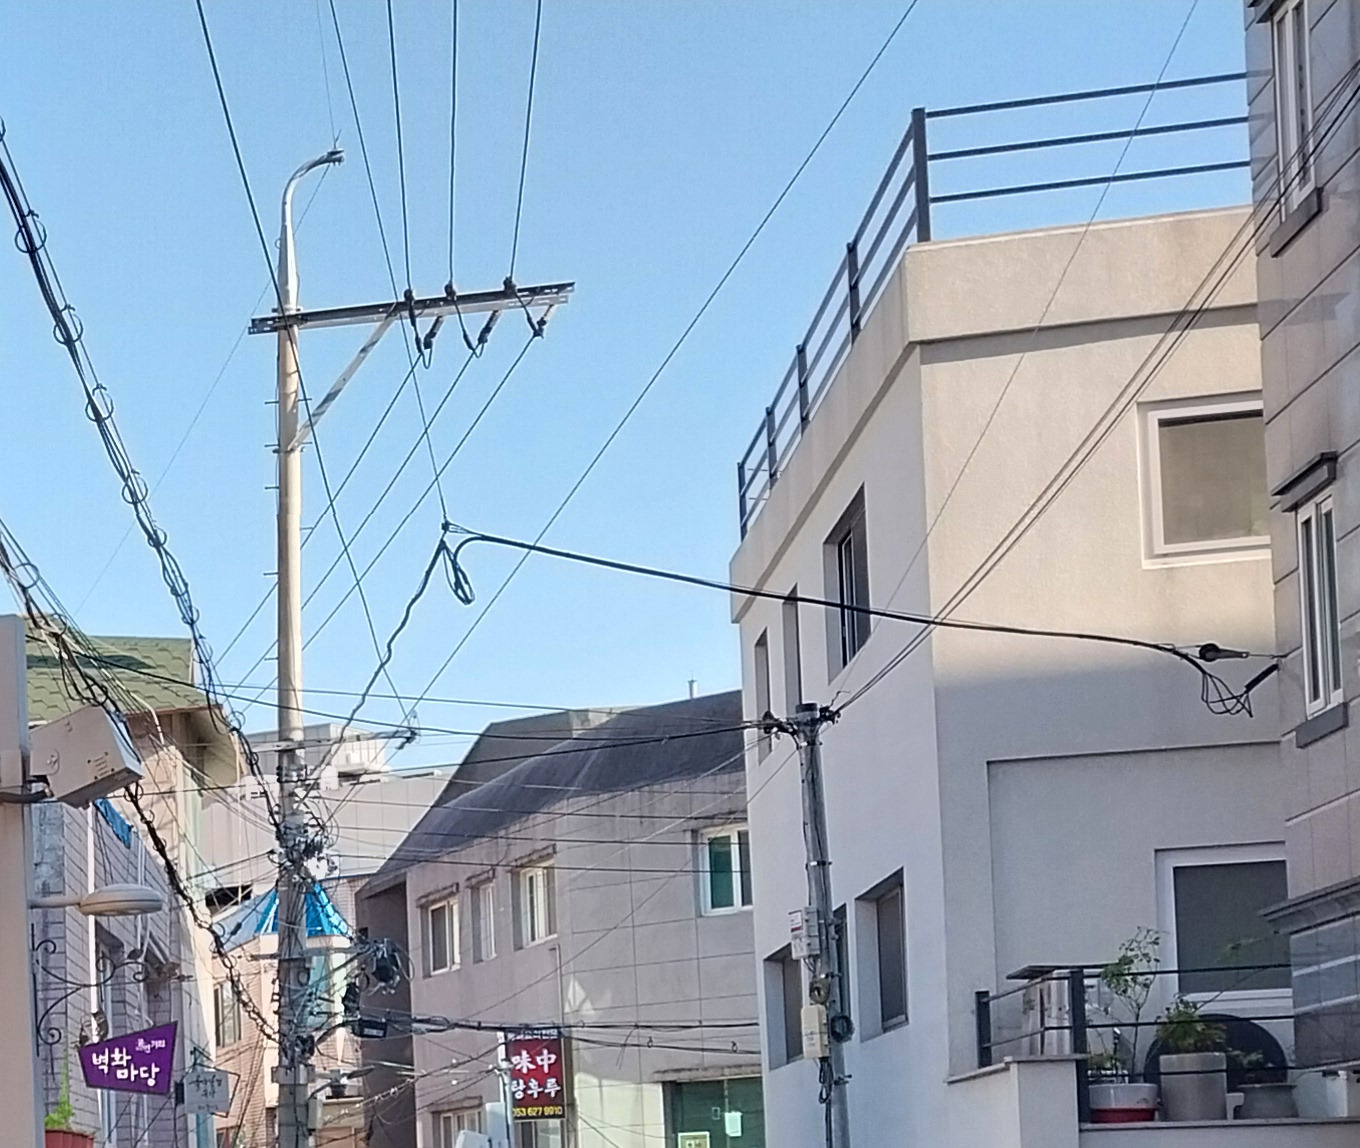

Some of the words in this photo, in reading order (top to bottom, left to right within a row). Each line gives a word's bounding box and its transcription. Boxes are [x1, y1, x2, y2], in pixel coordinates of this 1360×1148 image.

[92, 1047, 132, 1075] 벽화
[511, 1048, 556, 1074] 味中
[116, 1063, 160, 1087] 마당
[511, 1078, 561, 1099] 탕후루
